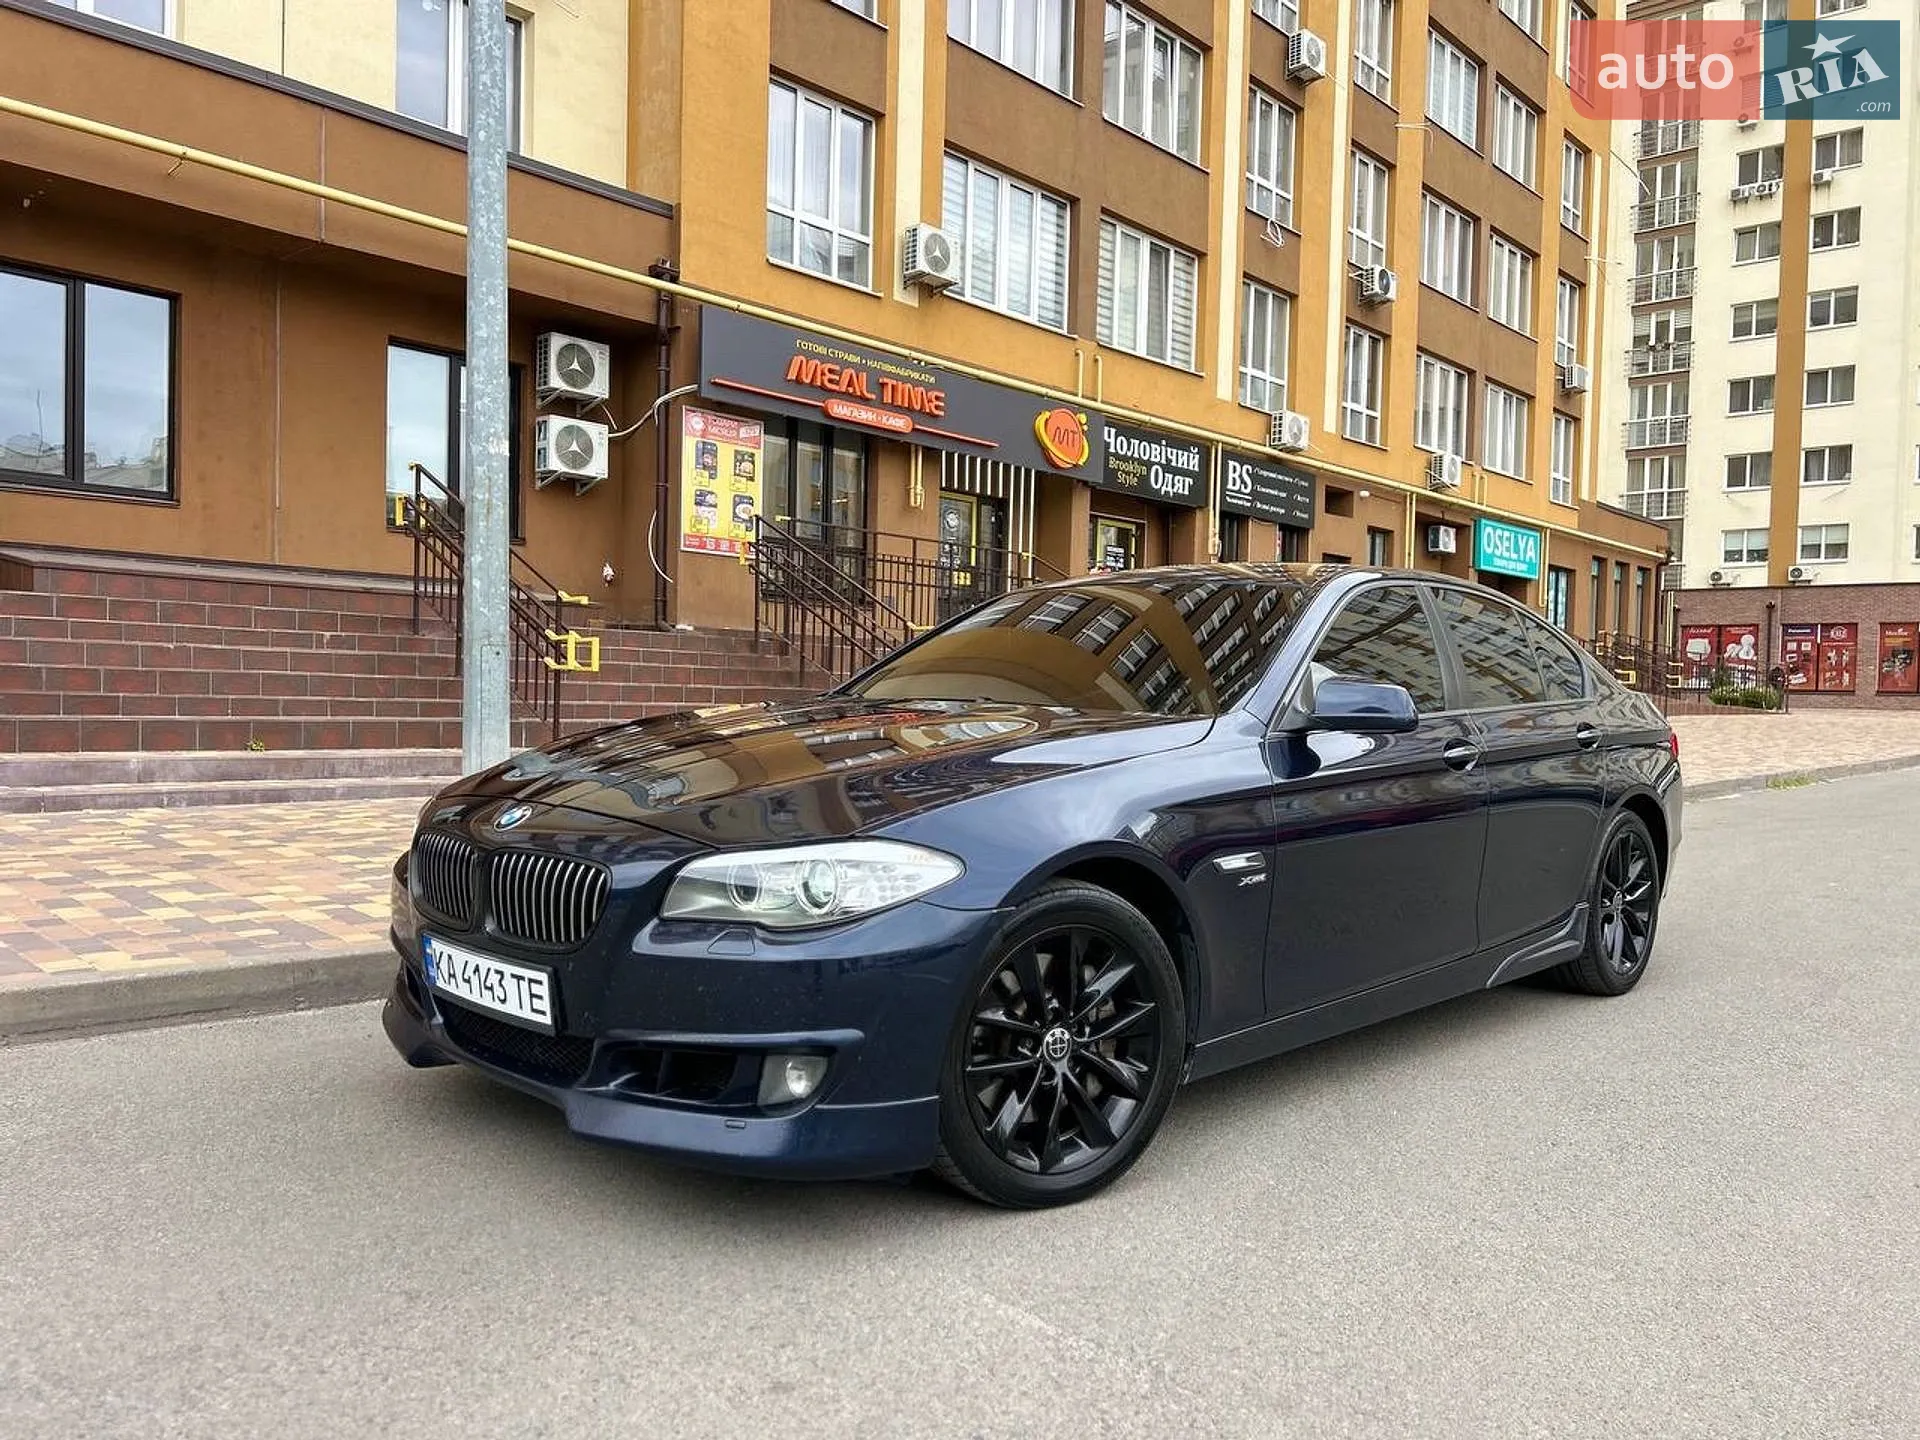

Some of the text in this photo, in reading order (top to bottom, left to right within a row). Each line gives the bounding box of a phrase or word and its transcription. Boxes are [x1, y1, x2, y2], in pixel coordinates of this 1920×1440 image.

[785, 353, 946, 417] MEAL TIME
[1103, 425, 1200, 472] Чоловічий
[1108, 456, 1148, 476] Brooklyn
[1117, 471, 1138, 487] Style
[1150, 464, 1194, 498] Одяг
[1226, 459, 1253, 494] BS
[1483, 526, 1537, 564] OSELYA
